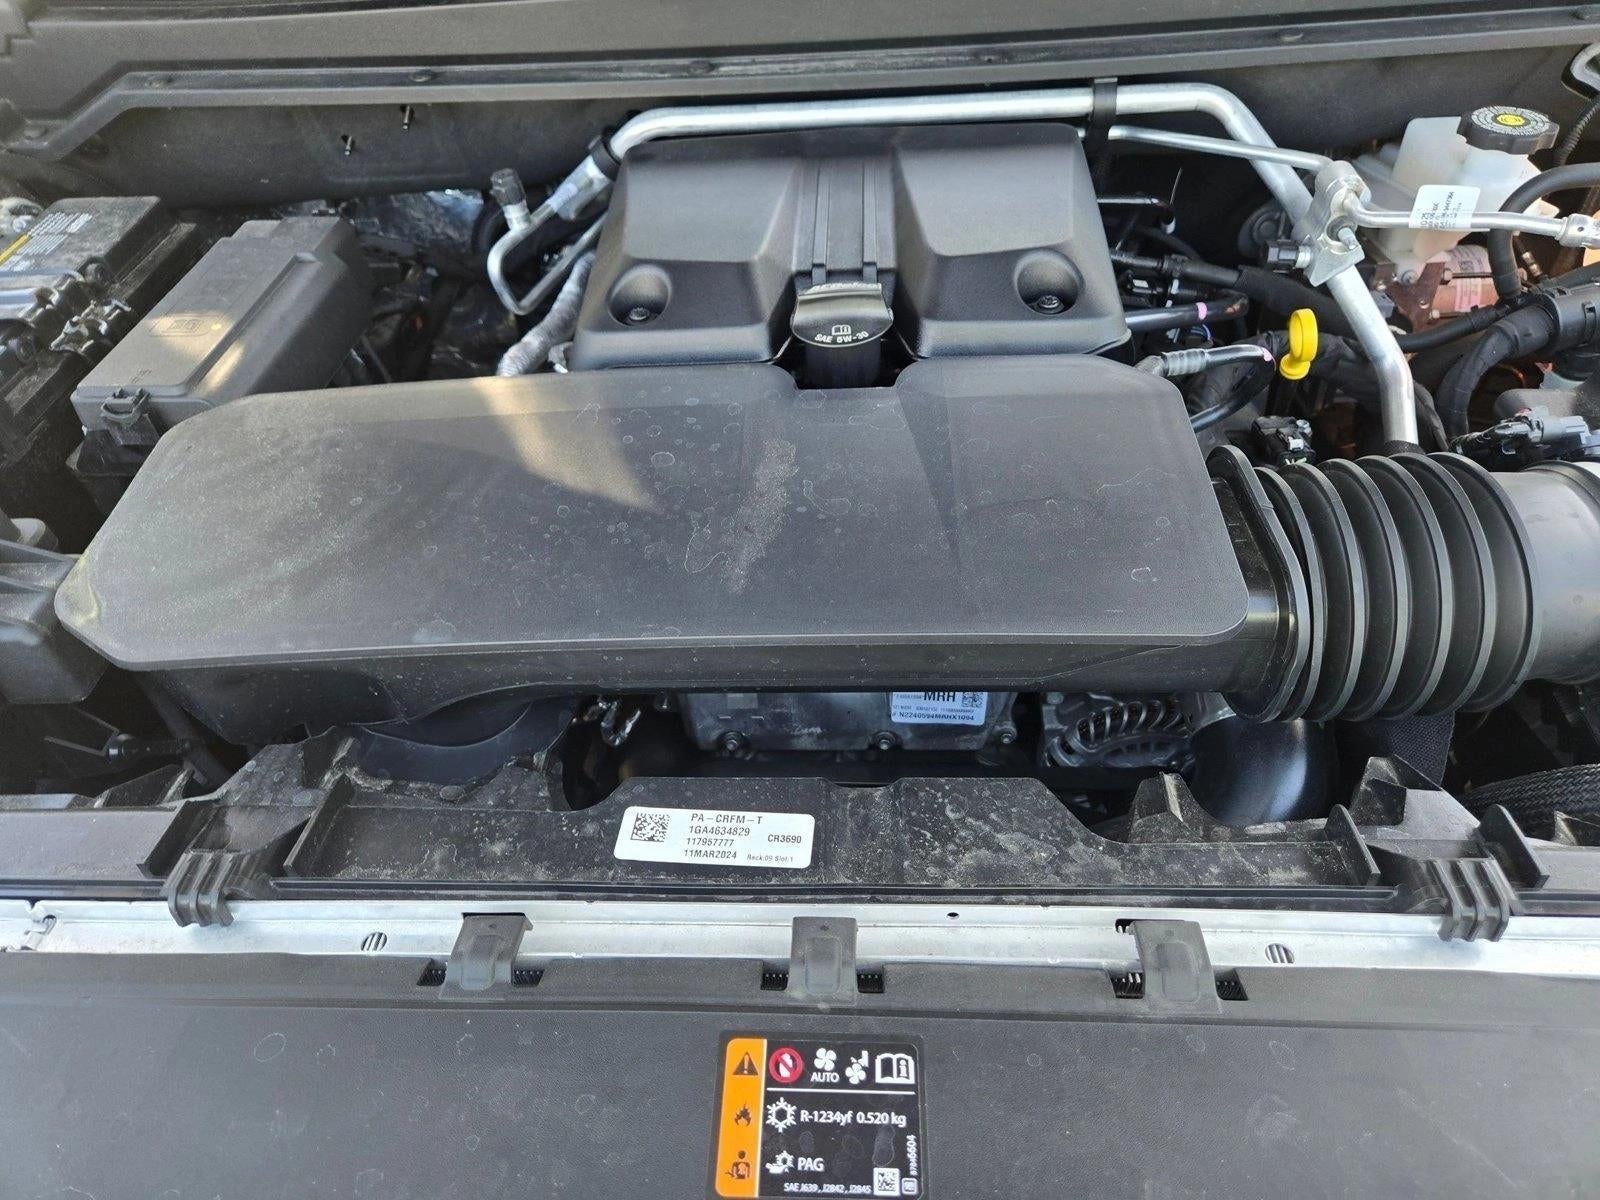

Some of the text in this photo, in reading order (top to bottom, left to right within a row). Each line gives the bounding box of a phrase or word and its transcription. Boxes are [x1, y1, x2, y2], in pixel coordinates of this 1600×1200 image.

[815, 330, 869, 343] SAE 5W-30
[923, 691, 956, 702] MRH
[690, 813, 763, 825] PA-CRFM-T
[688, 825, 751, 837] 1GA4634829
[686, 837, 735, 847] 117957777
[767, 834, 802, 844] CR3690
[684, 849, 737, 859] 11MAR2024
[810, 1072, 840, 1083] AUTO
[800, 1111, 907, 1128] R-1234yf 0.520 kg
[797, 1157, 825, 1171] PAG
[783, 1182, 799, 1192] SAE
